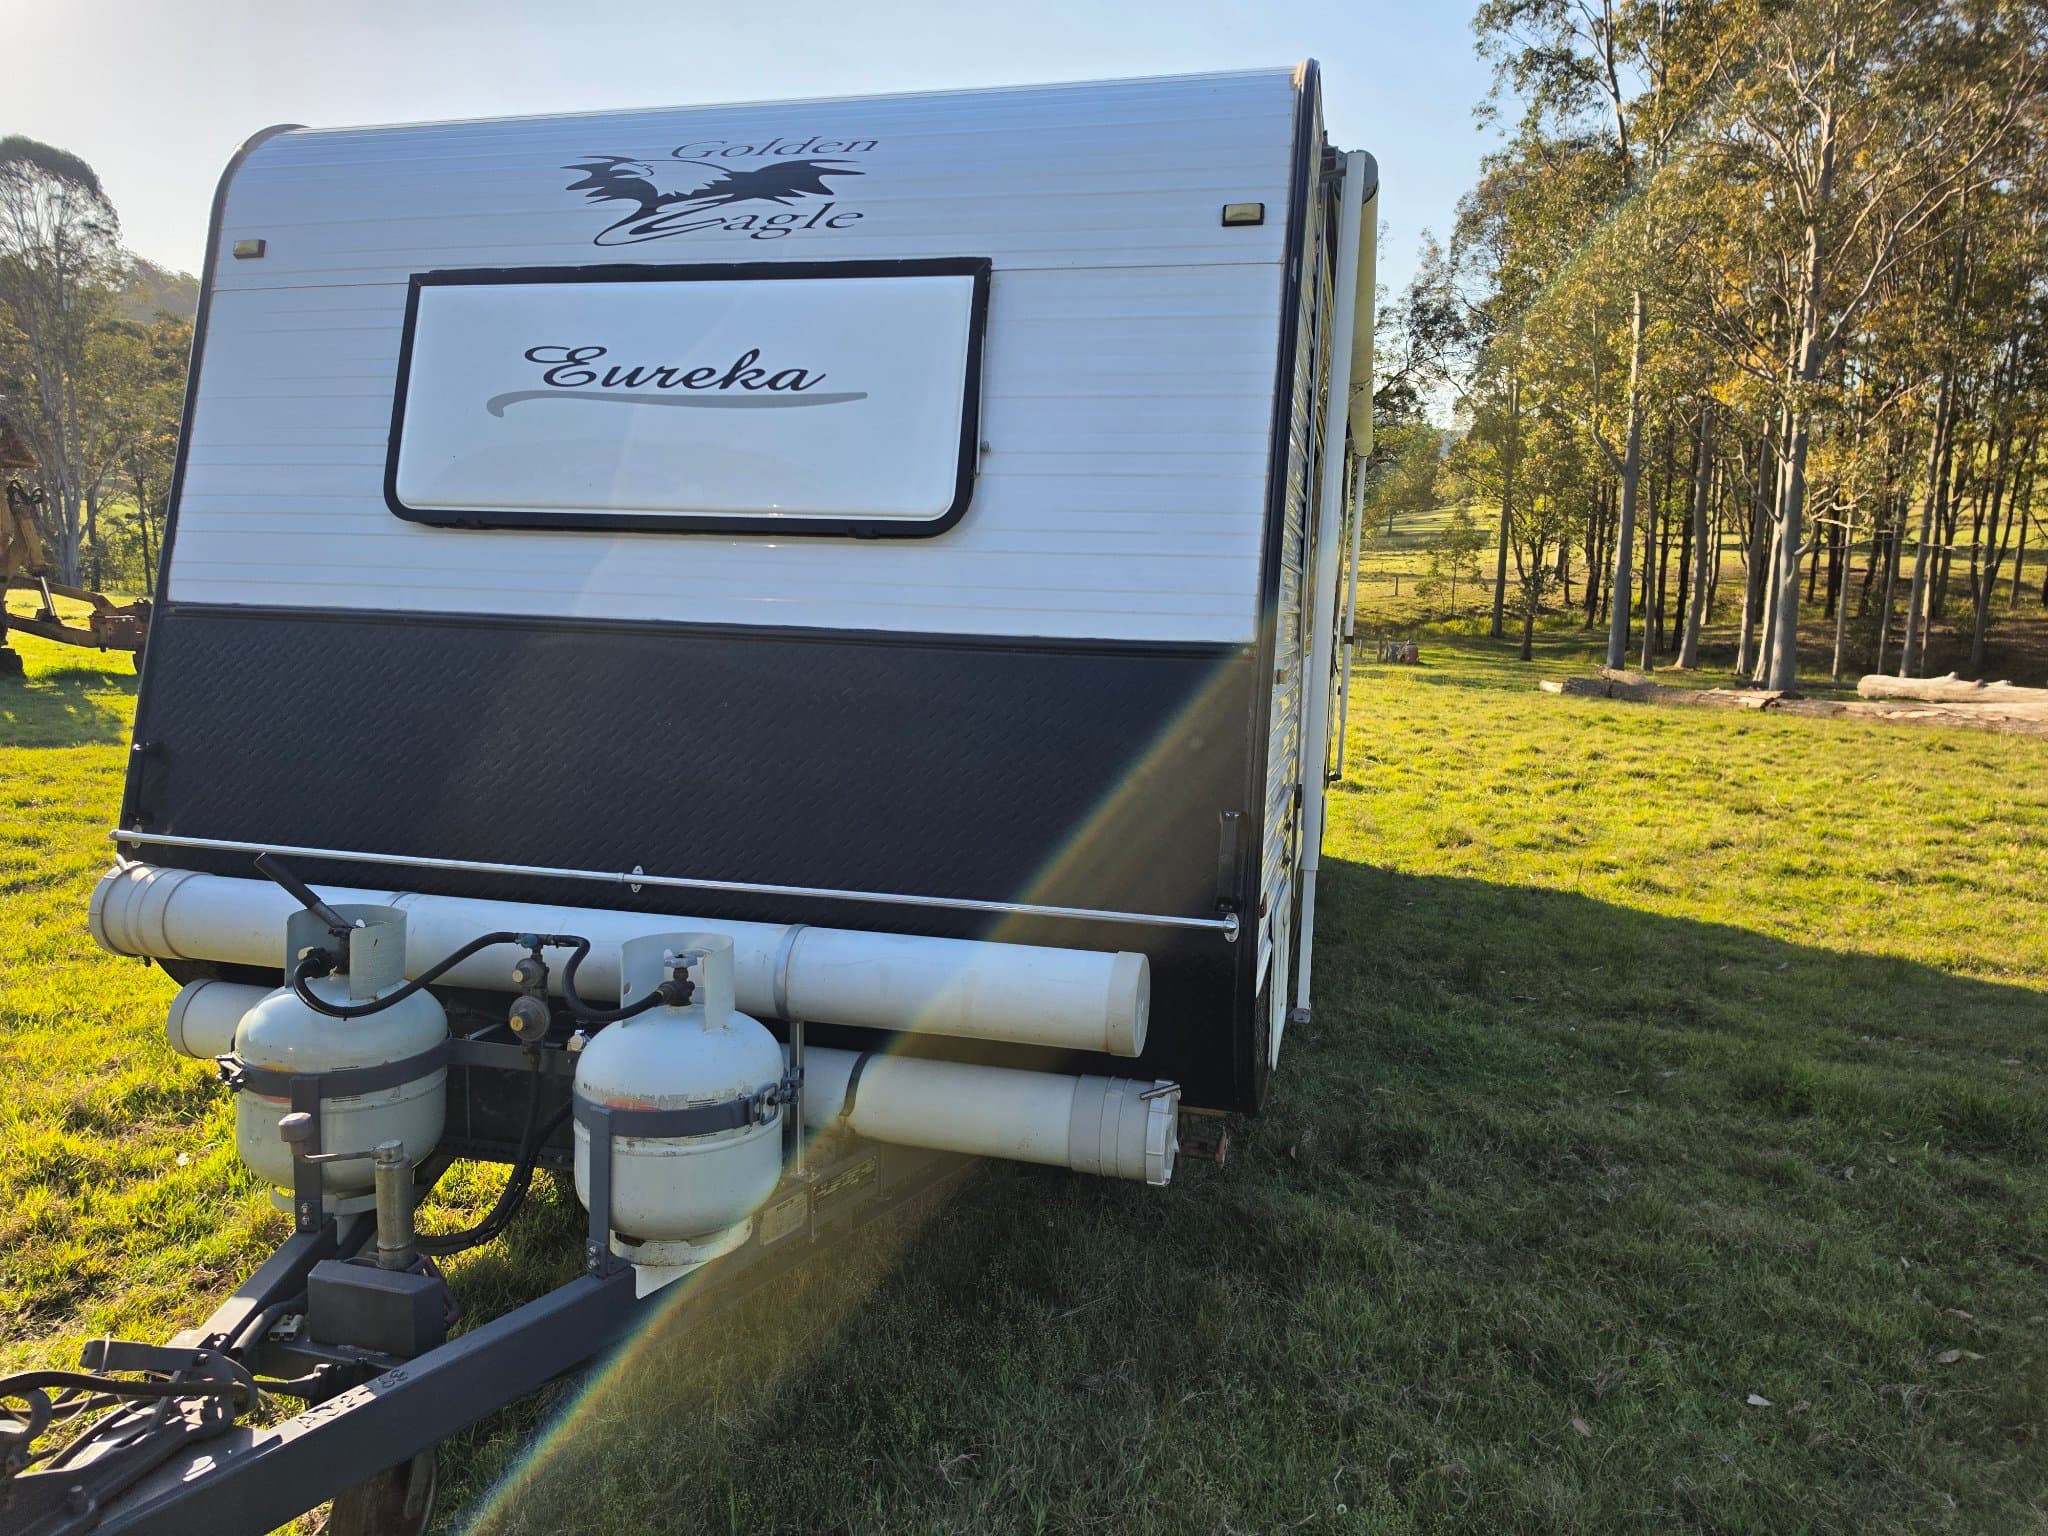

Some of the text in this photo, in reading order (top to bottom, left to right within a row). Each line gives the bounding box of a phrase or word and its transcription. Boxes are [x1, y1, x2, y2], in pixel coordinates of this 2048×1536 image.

[671, 135, 879, 159] Golden
[593, 199, 864, 246] Eagle
[524, 346, 826, 391] Eureka
